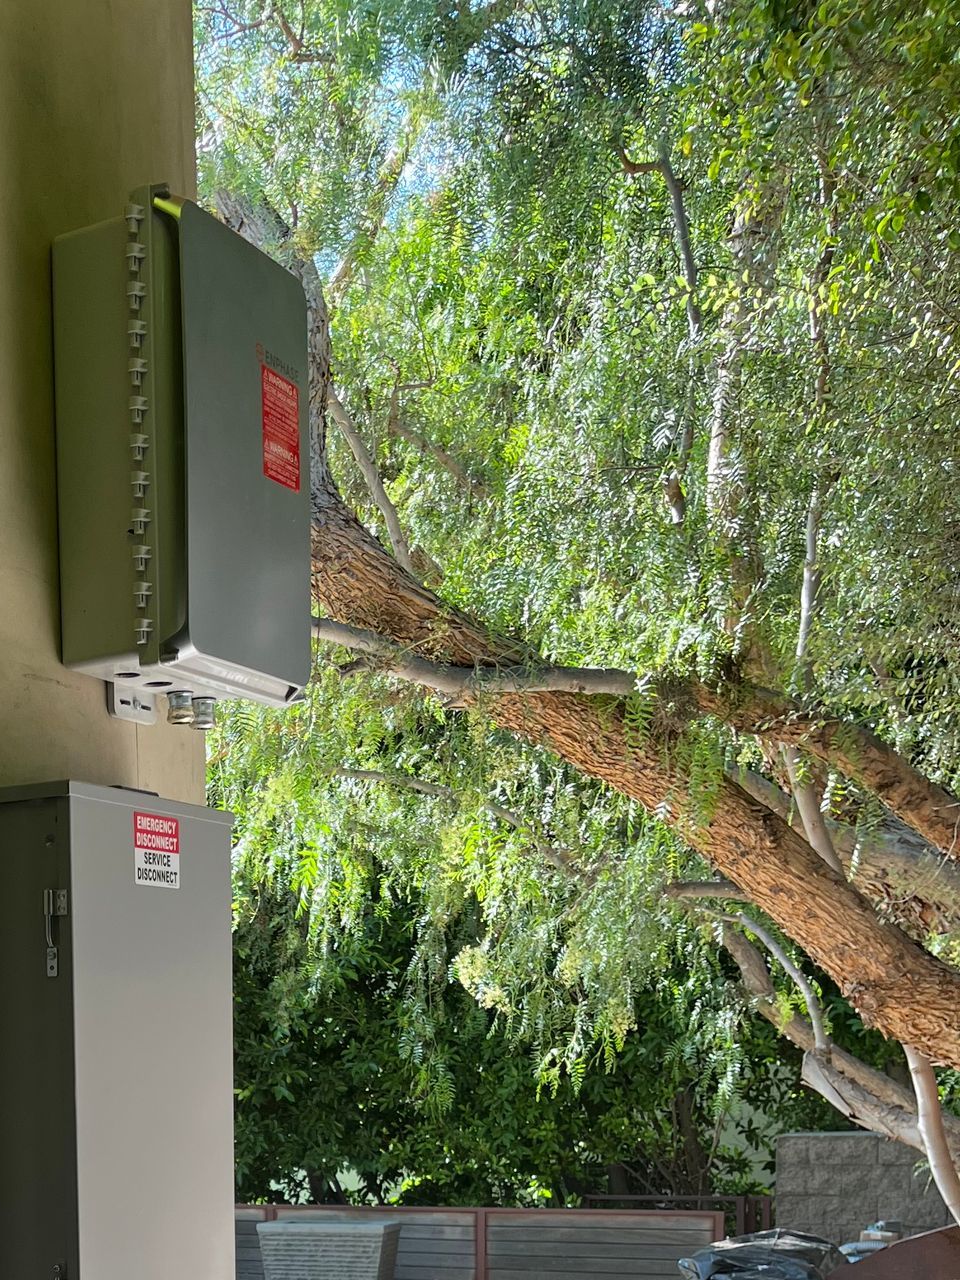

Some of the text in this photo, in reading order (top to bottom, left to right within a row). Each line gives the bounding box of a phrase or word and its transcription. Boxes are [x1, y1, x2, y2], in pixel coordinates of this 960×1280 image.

[268, 371, 293, 396] WARNING
[269, 441, 294, 463] WARNING
[136, 816, 177, 835] EMERGENCY
[136, 832, 177, 851] DISCONNECT
[143, 851, 171, 868] SERVICE
[137, 867, 178, 884] DISCONNECT
